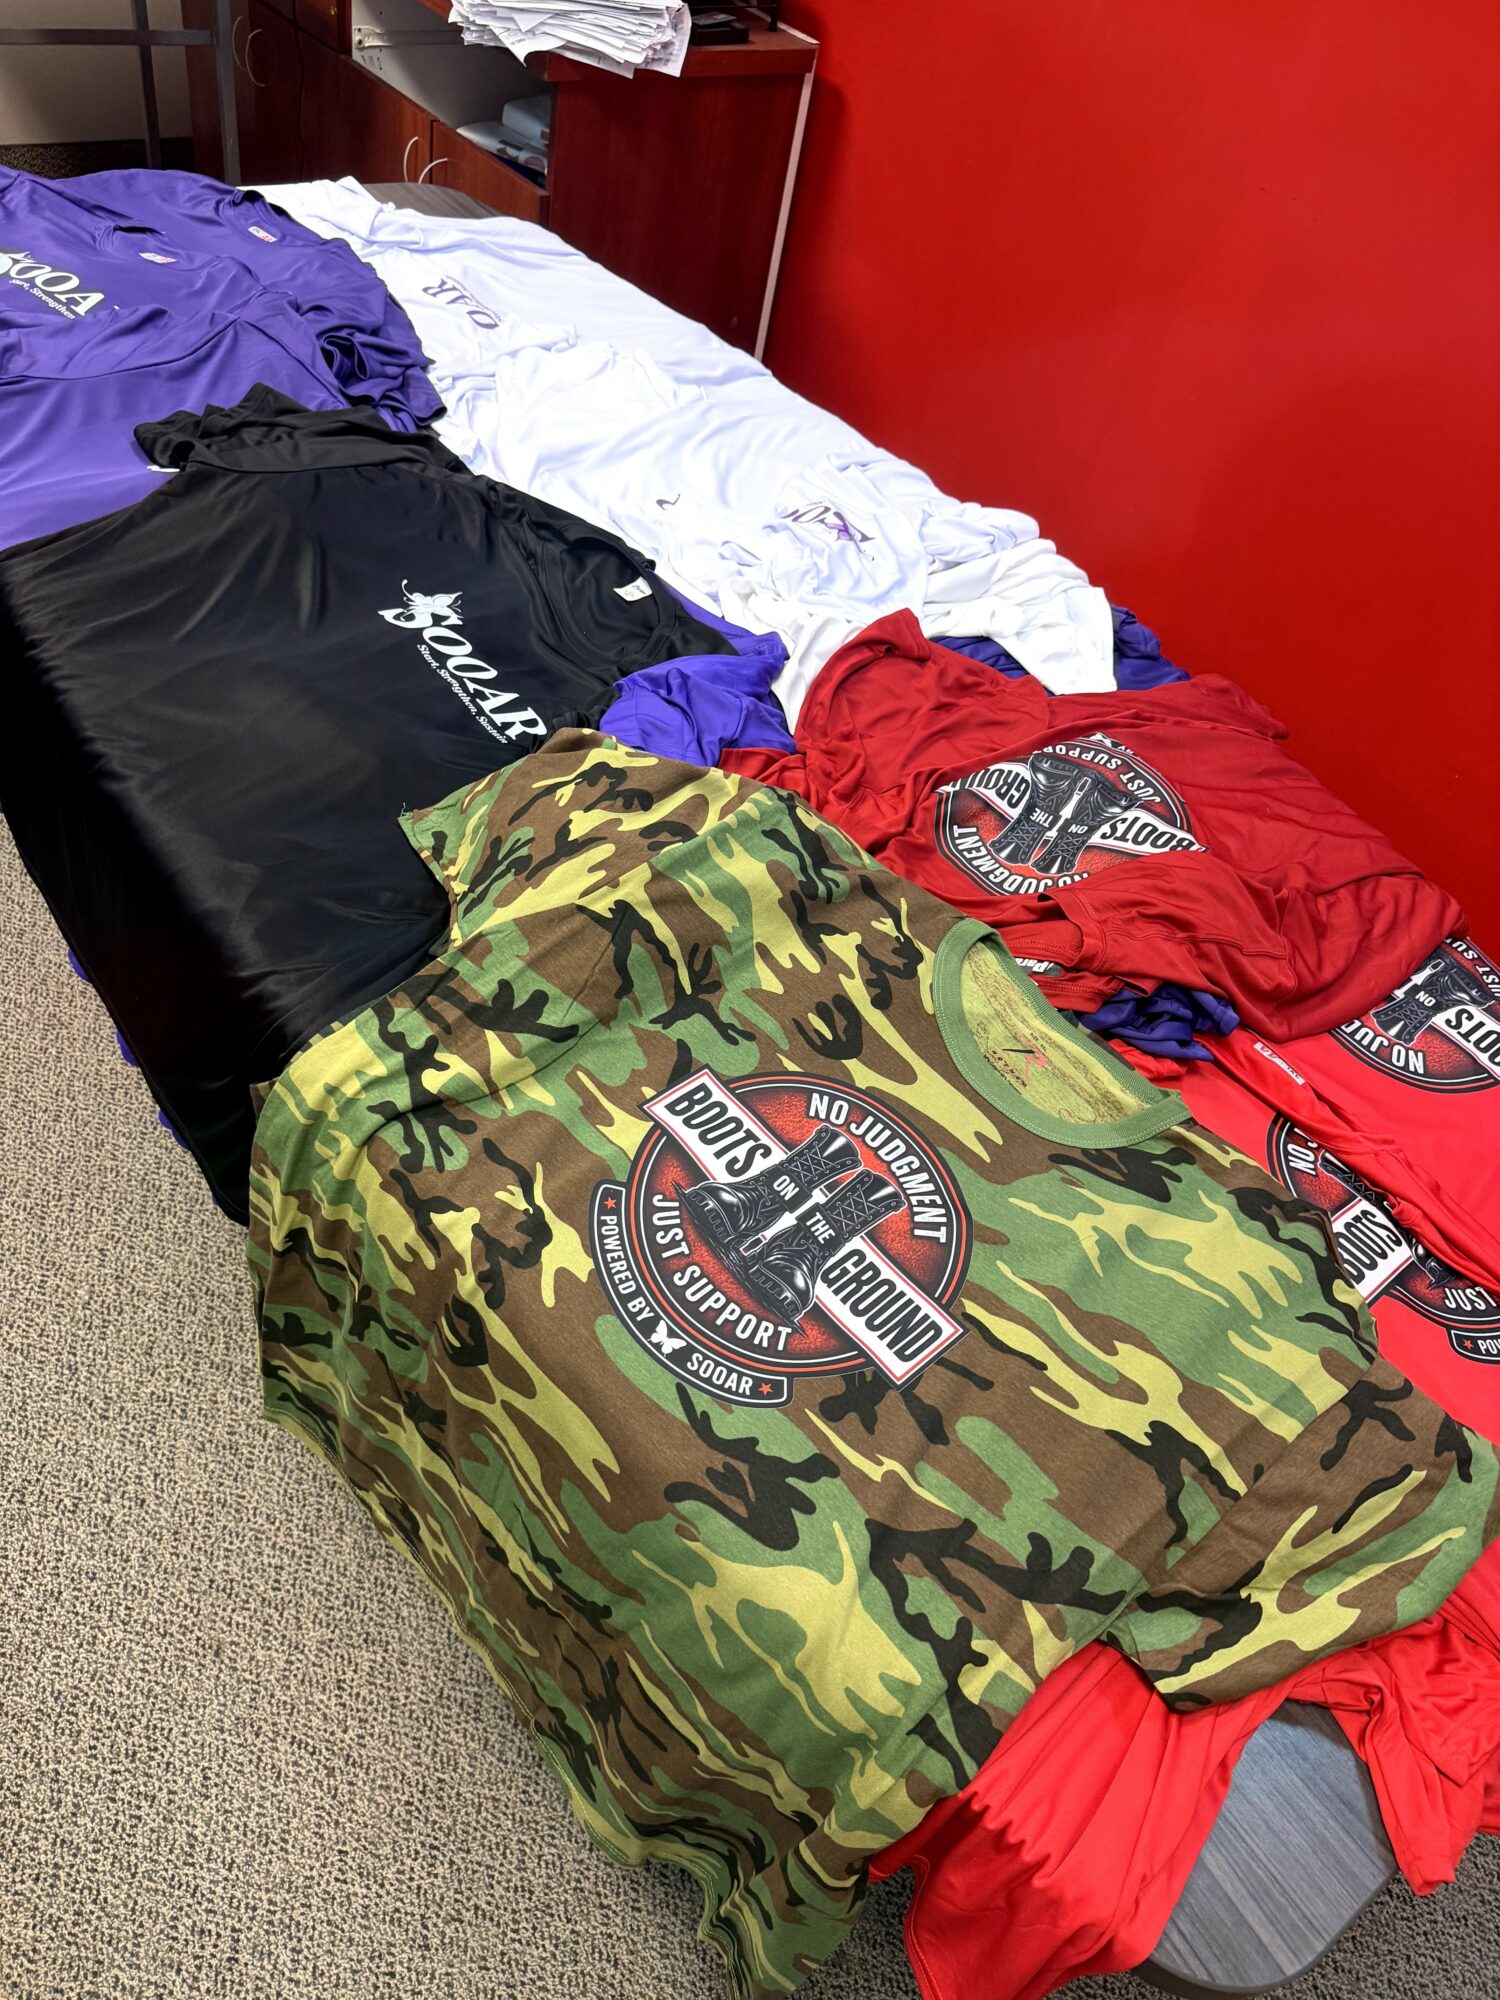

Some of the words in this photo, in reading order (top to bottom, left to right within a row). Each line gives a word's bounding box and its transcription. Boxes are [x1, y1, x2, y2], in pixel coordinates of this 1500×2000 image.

[377, 590, 547, 741] SOOAR
[416, 643, 439, 674] Start,
[436, 667, 477, 716] Strengthen,
[1120, 771, 1161, 804] JUST
[1029, 807, 1054, 828] THE
[1067, 824, 1088, 834] ON
[1414, 990, 1436, 1007] ON
[1391, 1044, 1425, 1074] NO
[664, 1082, 772, 1179] BOOTS
[808, 1093, 849, 1123] NO
[849, 1119, 948, 1244] JUDGMENT
[1287, 1143, 1317, 1176] NO
[772, 1175, 799, 1200] ON
[805, 1212, 836, 1245] THE
[652, 1193, 690, 1259] JUST
[672, 1266, 792, 1352] SUPPORT
[600, 1214, 638, 1295] POWERED
[626, 1294, 654, 1323] BY
[686, 1351, 753, 1396] SOOAR
[821, 1248, 943, 1364] GROUND
